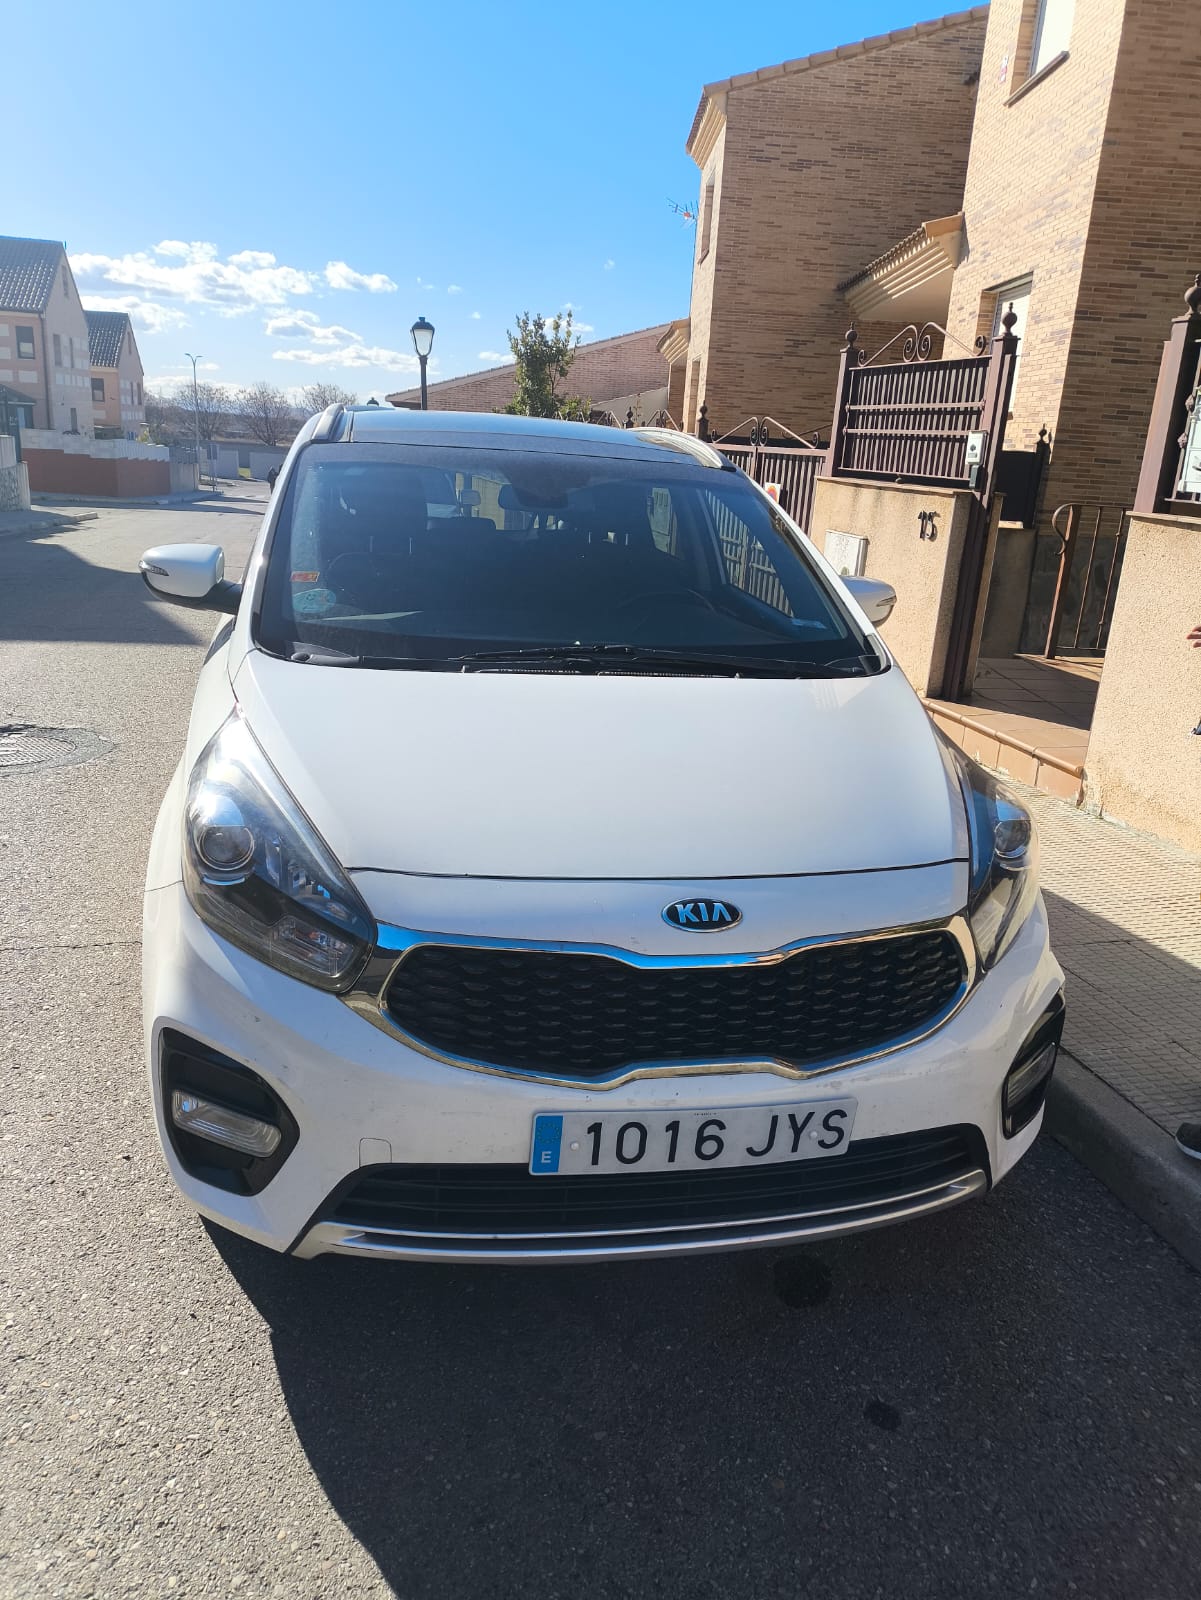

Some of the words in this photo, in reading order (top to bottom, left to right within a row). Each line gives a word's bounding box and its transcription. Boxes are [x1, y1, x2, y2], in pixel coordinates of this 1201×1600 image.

[675, 902, 732, 924] KIA
[587, 1119, 726, 1166] 1016
[746, 1109, 848, 1157] JYS
[541, 1151, 552, 1163] E
